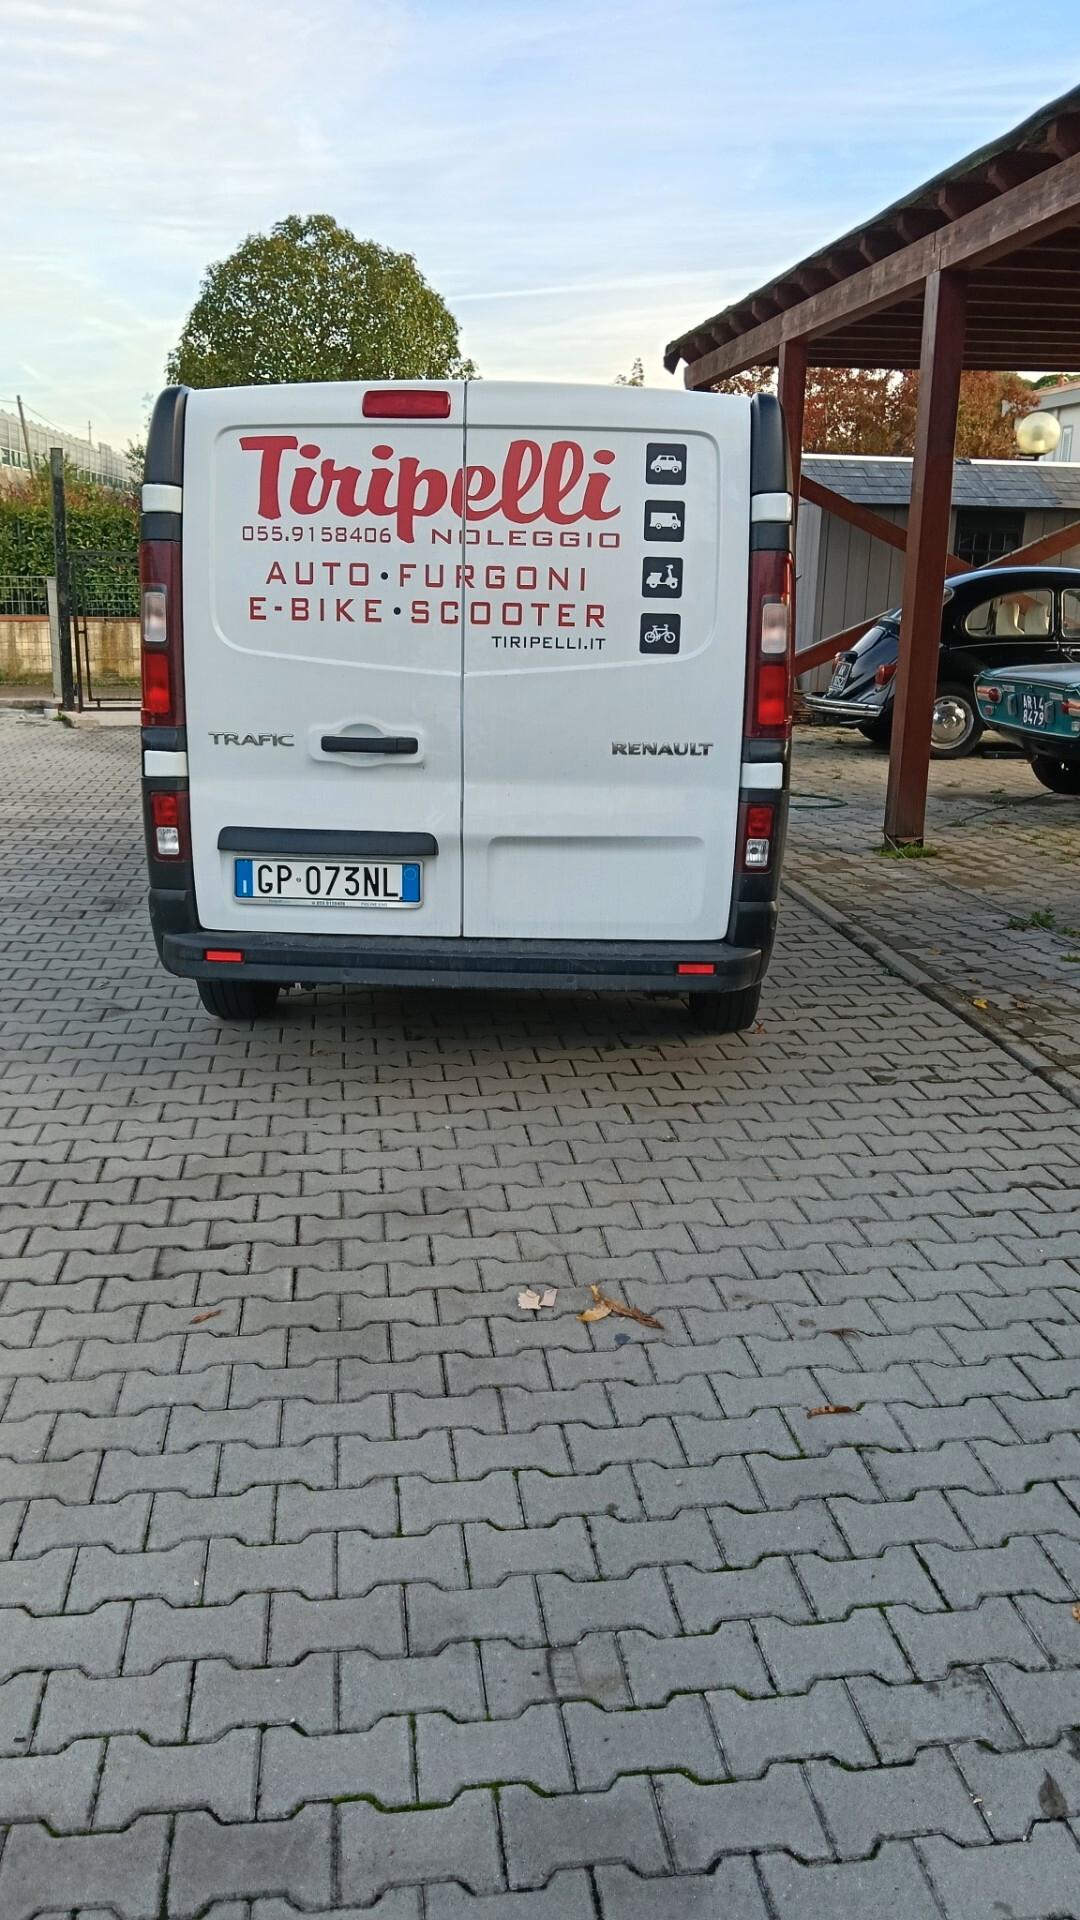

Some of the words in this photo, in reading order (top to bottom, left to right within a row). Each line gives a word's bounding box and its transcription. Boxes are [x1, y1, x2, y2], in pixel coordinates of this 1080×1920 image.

[239, 435, 621, 543] Tiripelli
[242, 525, 392, 543] 055.9158406
[431, 528, 620, 548] NOLEGGIO
[491, 636, 606, 651] TIRIPELLI.IT
[1023, 709, 1044, 726] 8479
[208, 732, 295, 747] TRAFIC
[611, 741, 714, 756] RENAULT
